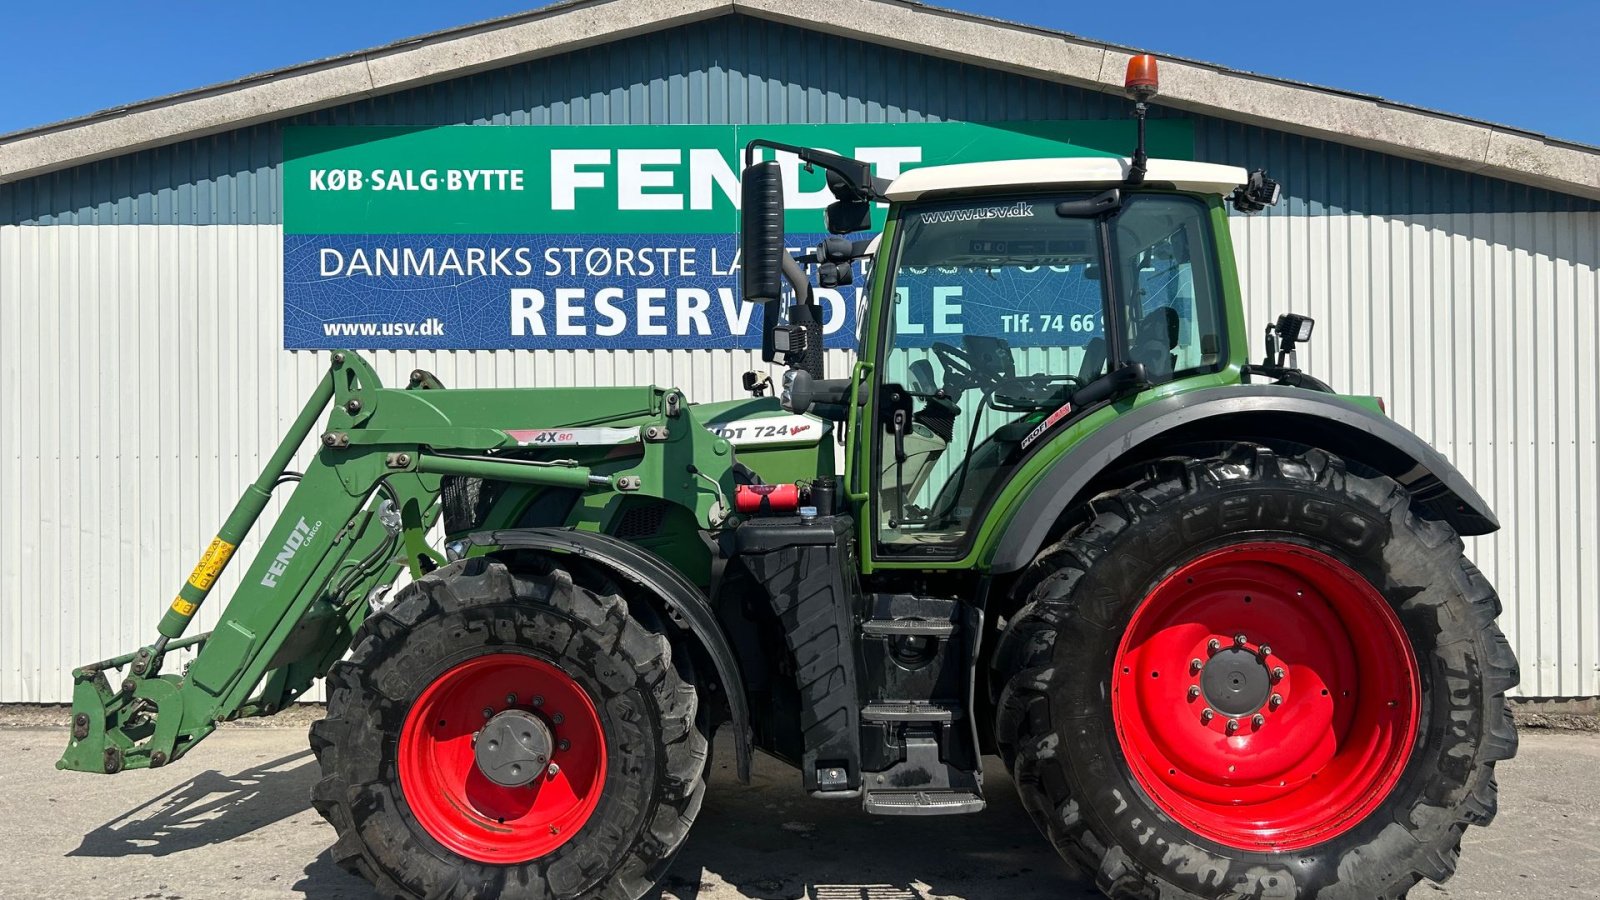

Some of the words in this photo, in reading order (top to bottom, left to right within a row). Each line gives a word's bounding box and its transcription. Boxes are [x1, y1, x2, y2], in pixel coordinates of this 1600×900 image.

[550, 145, 923, 211] FENDT
[920, 202, 1034, 225] www.usv.dk
[319, 247, 532, 277] DANMARKS
[544, 247, 697, 277] STØRSTE
[323, 319, 446, 338] www.usv.dk
[1001, 313, 1034, 334] Tlf.
[1039, 314, 1064, 333] 74
[1070, 313, 1094, 333] 66
[754, 425, 788, 438] 724
[303, 520, 323, 547] CARGO
[260, 515, 311, 588] FENDT
